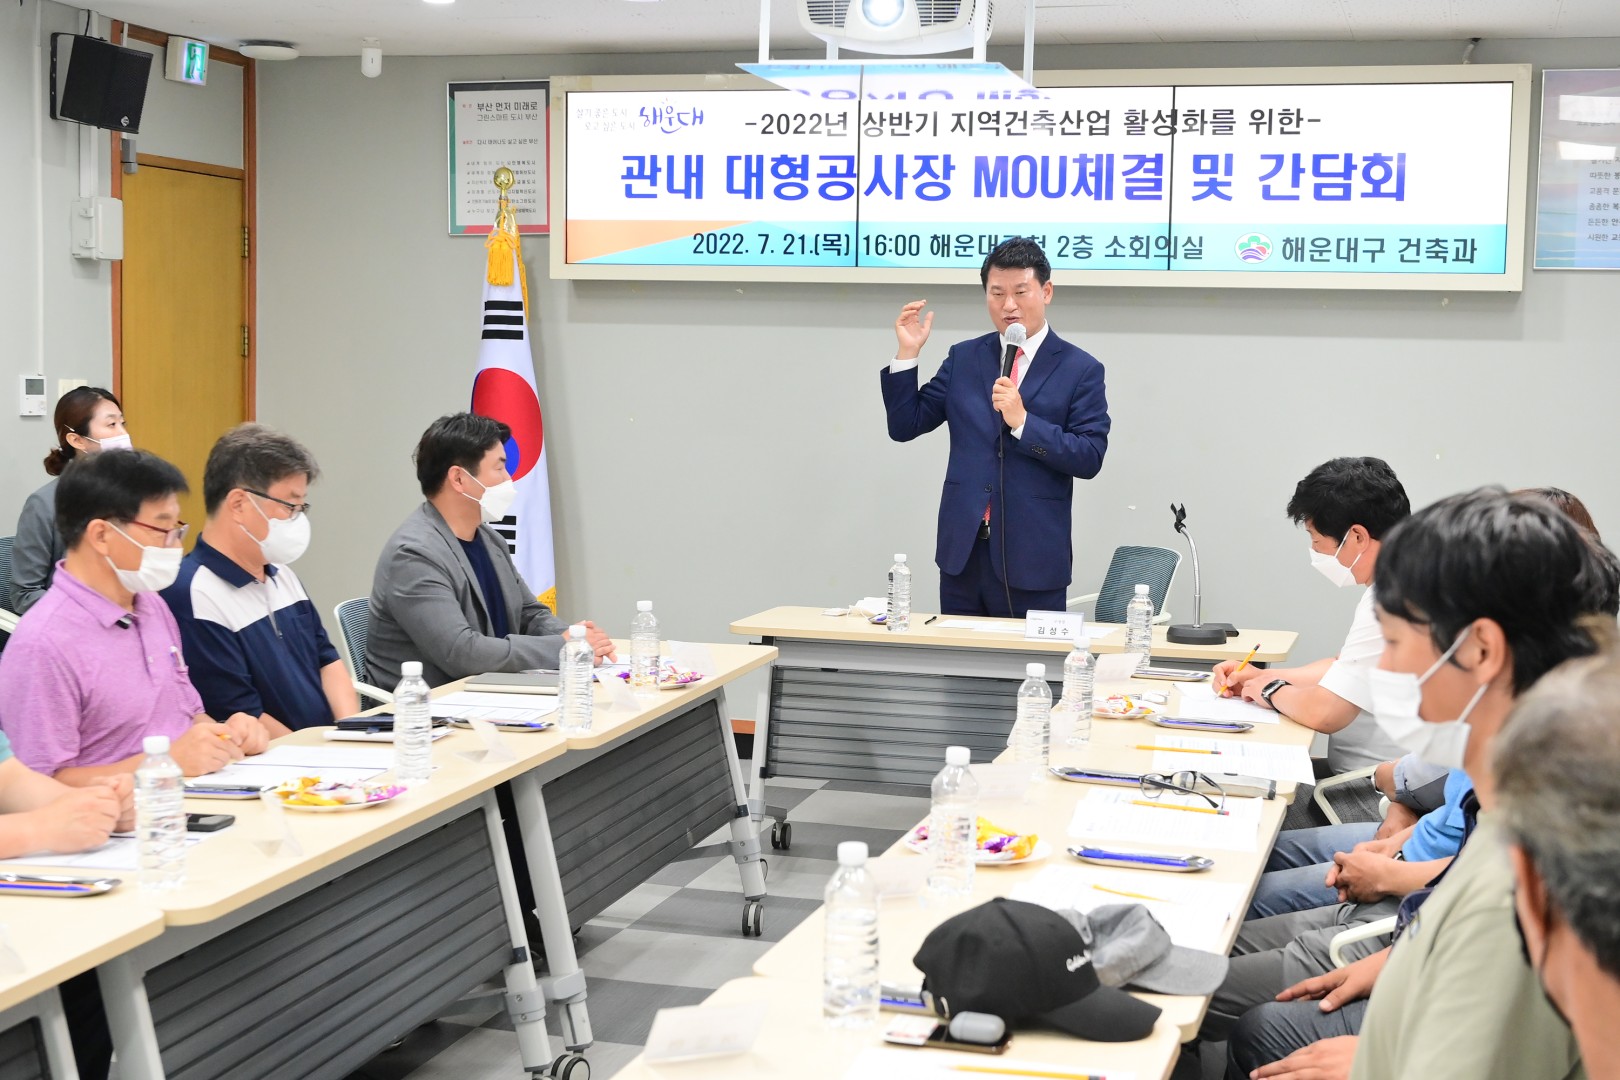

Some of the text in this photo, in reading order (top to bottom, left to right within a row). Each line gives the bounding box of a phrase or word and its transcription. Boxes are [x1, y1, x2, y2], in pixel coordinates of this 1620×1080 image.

[477, 101, 538, 112] 부산 먼저 미래로
[477, 114, 509, 122] 그린스마트
[525, 113, 538, 121] 부산
[638, 105, 704, 134] 해운대
[745, 107, 1322, 138] -2022년 상반기 지역건축산업 활성화를 위한-
[620, 151, 1407, 202] 관내 대형공사장 MOU체결 및 간담회
[692, 232, 749, 255] 2022.
[758, 232, 775, 255] 7.
[863, 234, 920, 257] 16:00
[1057, 234, 1094, 259] 2층
[1104, 234, 1204, 260] 소회의실
[1281, 236, 1477, 264] 해운대구 건축과
[1037, 626, 1069, 636] 김성수
